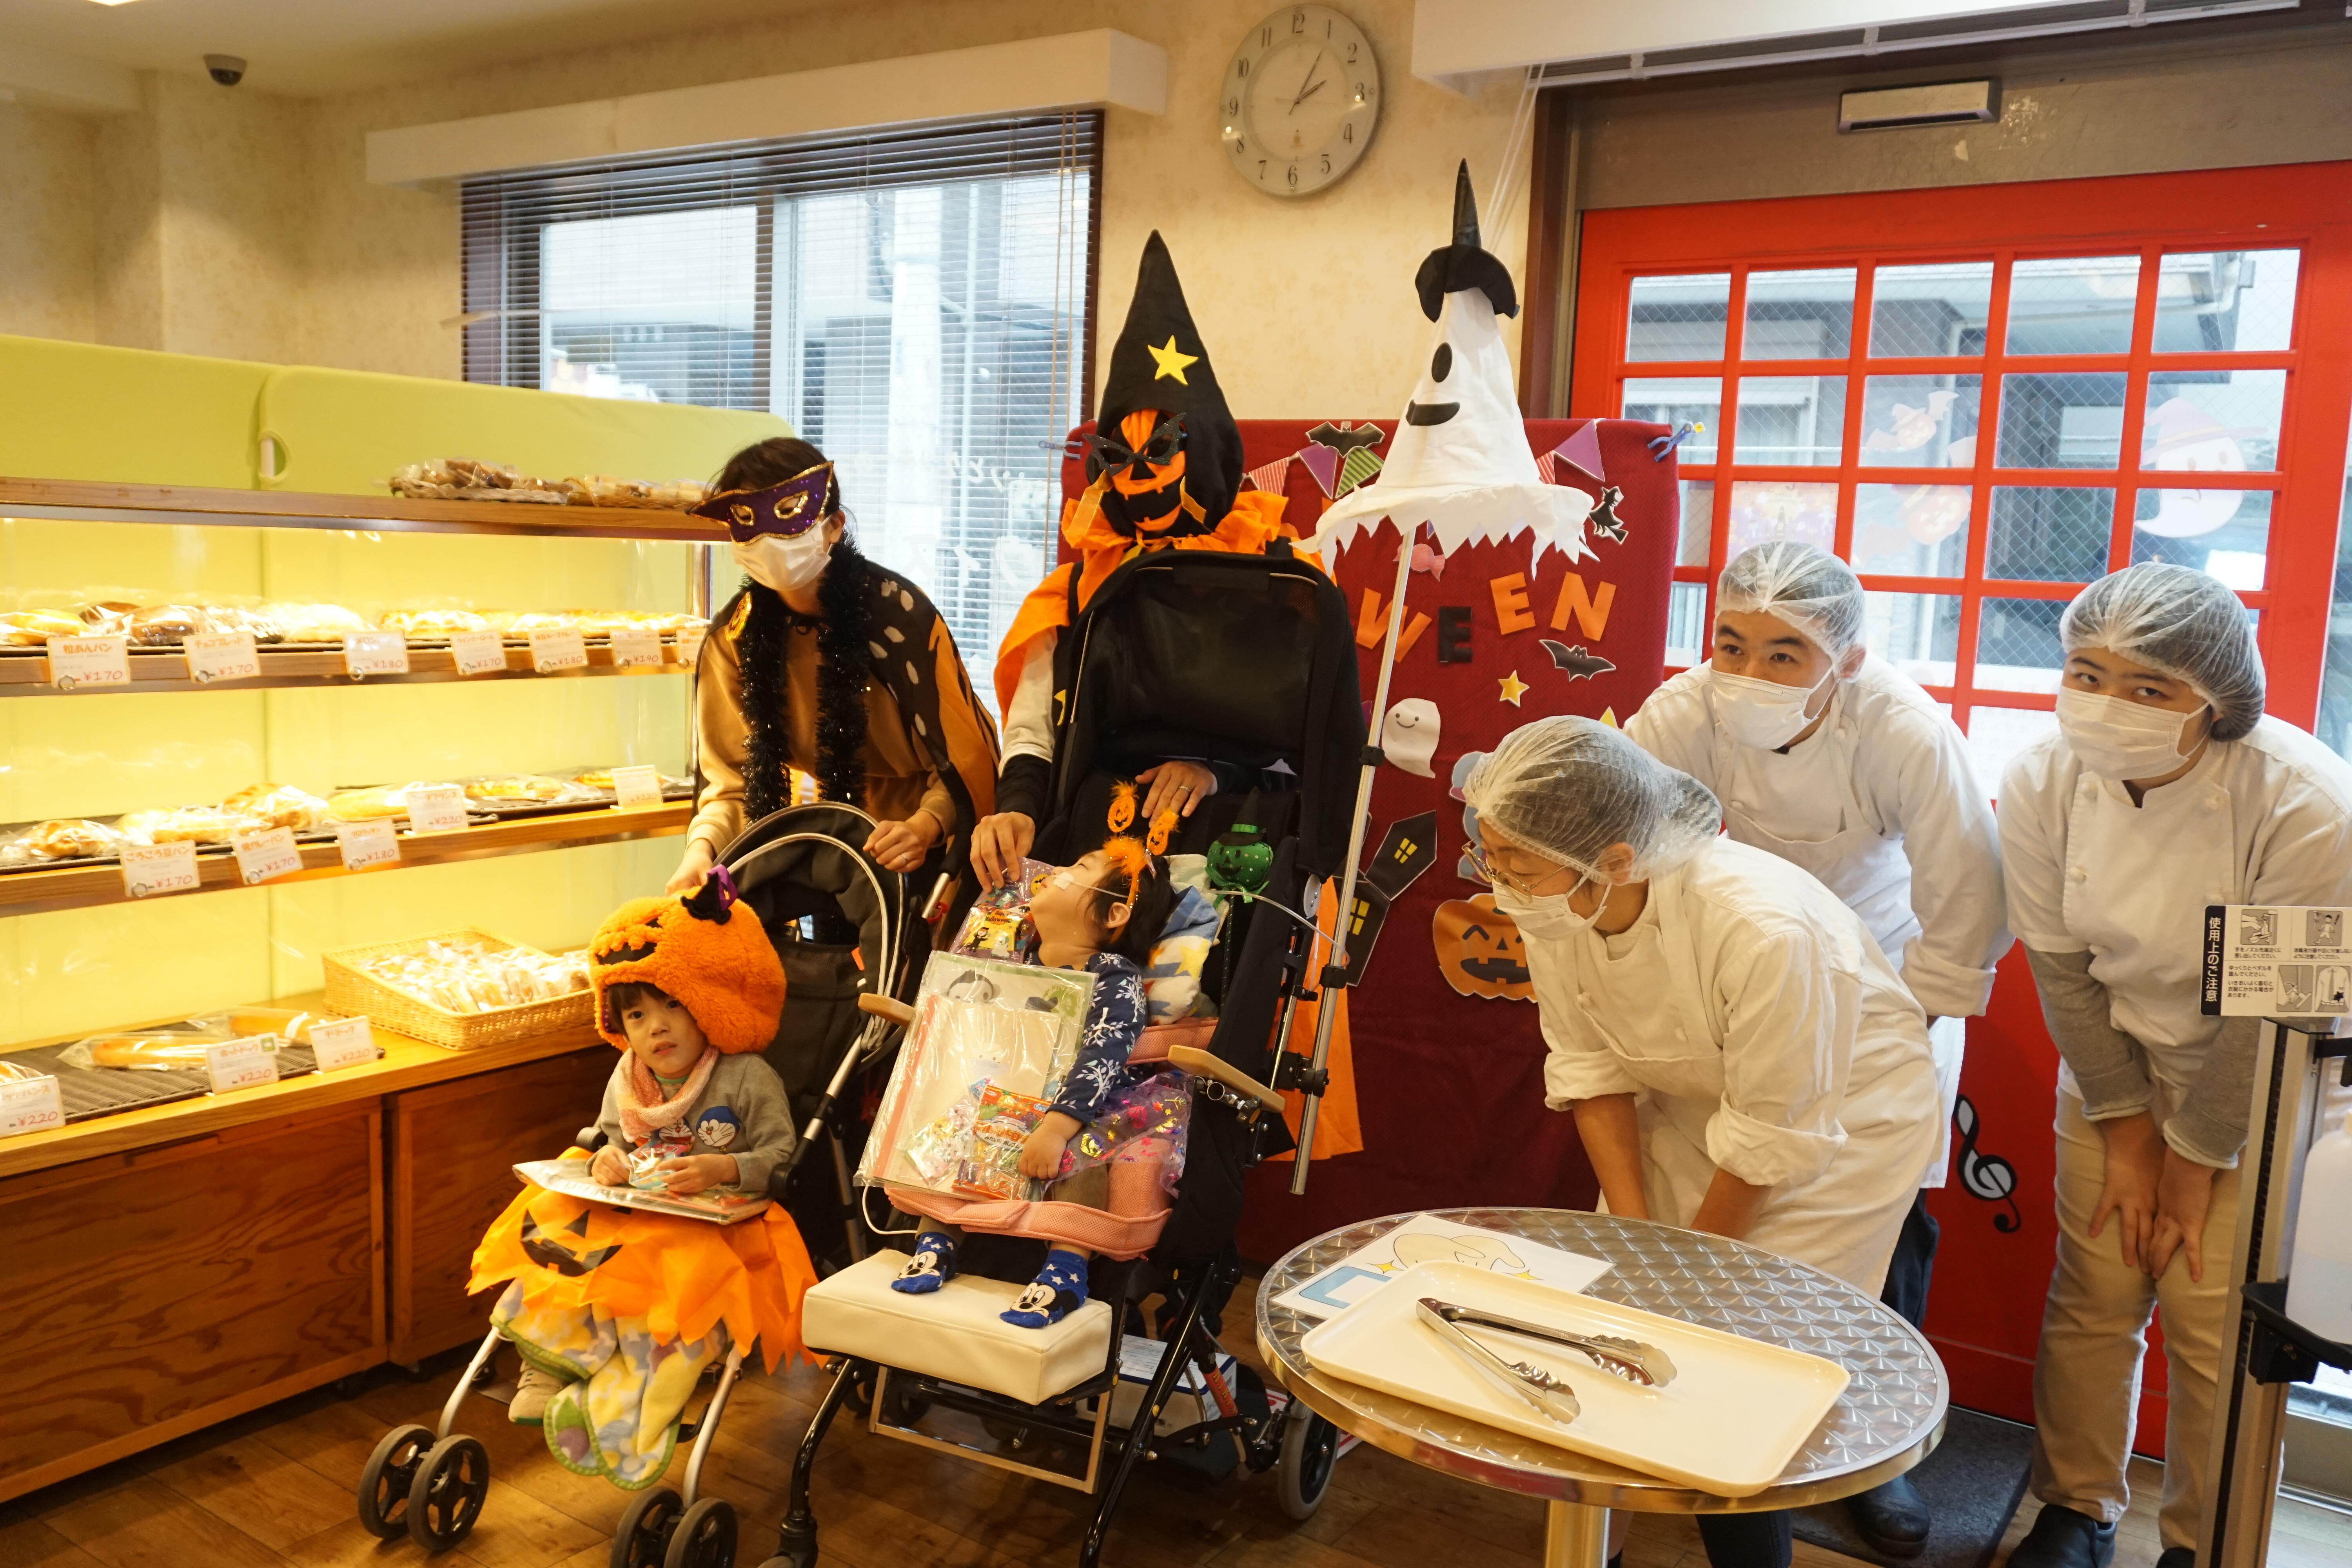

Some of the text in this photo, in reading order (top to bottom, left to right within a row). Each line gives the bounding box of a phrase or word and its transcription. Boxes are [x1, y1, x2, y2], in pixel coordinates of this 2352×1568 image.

[1292, 13, 1305, 34] 12
[1327, 19, 1332, 39] 1
[1262, 27, 1271, 47] 11
[1348, 43, 1357, 63] 2
[1238, 58, 1249, 78] 10
[1355, 82, 1365, 100] 3
[1230, 97, 1238, 116] 9
[1344, 123, 1352, 143] 4
[1237, 134, 1244, 153] 8
[1259, 160, 1267, 180] 7
[1321, 154, 1330, 174] 5
[1288, 165, 1298, 185] 6
[1356, 571, 1617, 662] WEEN
[372, 659, 403, 668] ¥180
[476, 657, 501, 667] ¥170
[558, 655, 583, 664] ¥180
[83, 670, 123, 681] ¥170
[218, 663, 253, 675] ¥170
[635, 792, 657, 800] ¥220
[434, 815, 463, 824] ¥220
[366, 849, 394, 860] ¥180
[265, 857, 295, 871] ¥170
[155, 875, 192, 887] ¥170
[2205, 917, 2222, 1002] 使用上のご注意
[341, 1048, 370, 1061] ¥220
[240, 1069, 272, 1082] ¥220
[18, 1111, 58, 1126] ¥220
